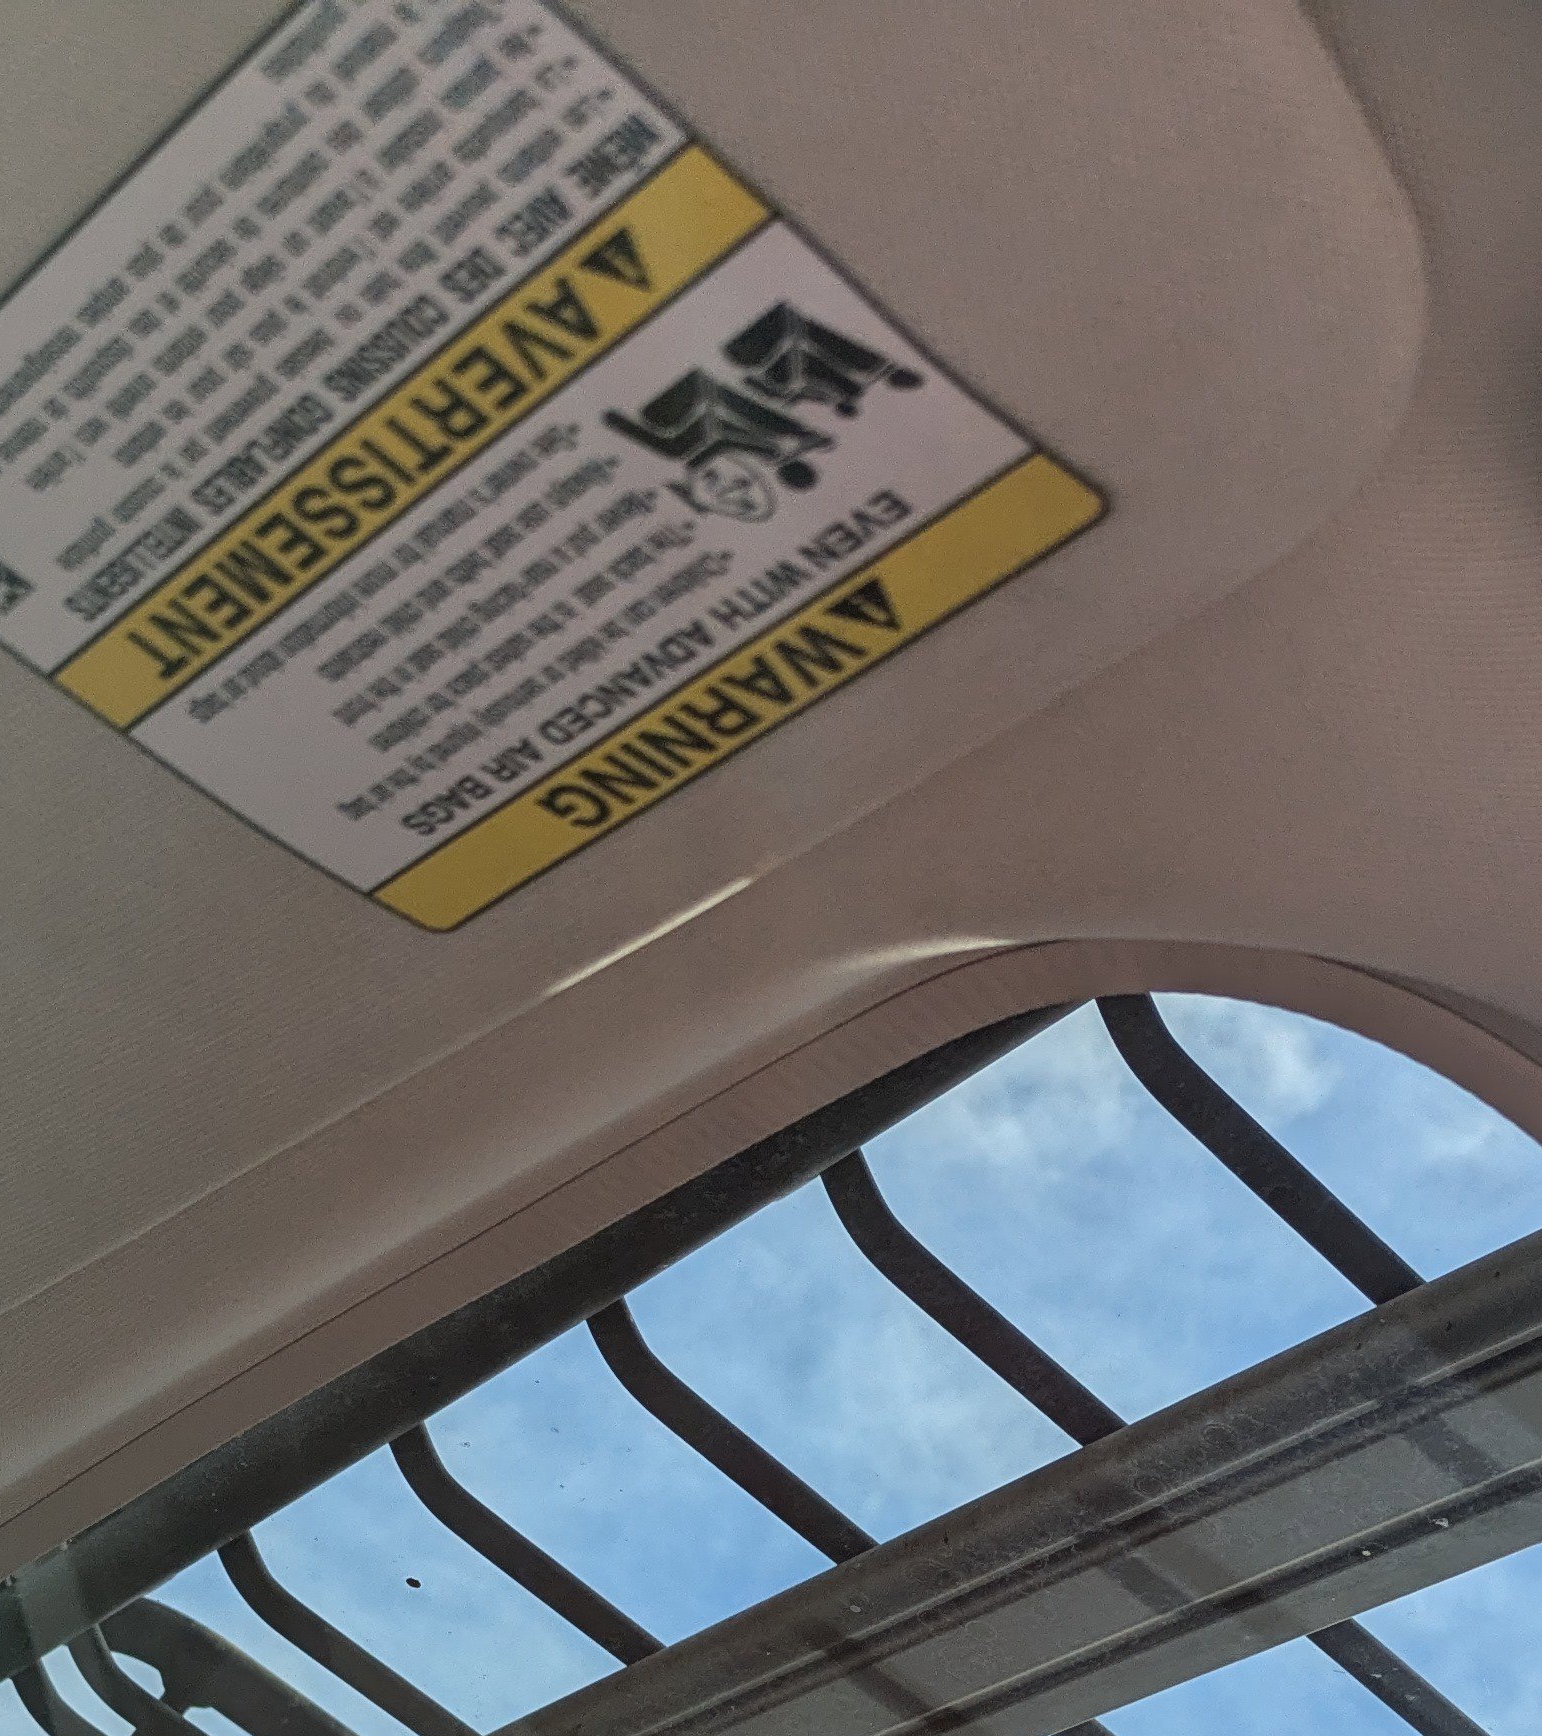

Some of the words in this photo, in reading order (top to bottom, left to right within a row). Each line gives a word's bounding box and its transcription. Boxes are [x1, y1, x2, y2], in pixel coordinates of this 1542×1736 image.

[433, 244, 508, 306] DES
[112, 276, 616, 683] AVERTISSEMENT
[792, 484, 919, 574] EVEN
[703, 553, 816, 633] WITH
[529, 615, 724, 748] ADVANCED
[473, 732, 550, 785] AIR
[530, 614, 868, 835] WARNING
[392, 770, 494, 839] BAGS
